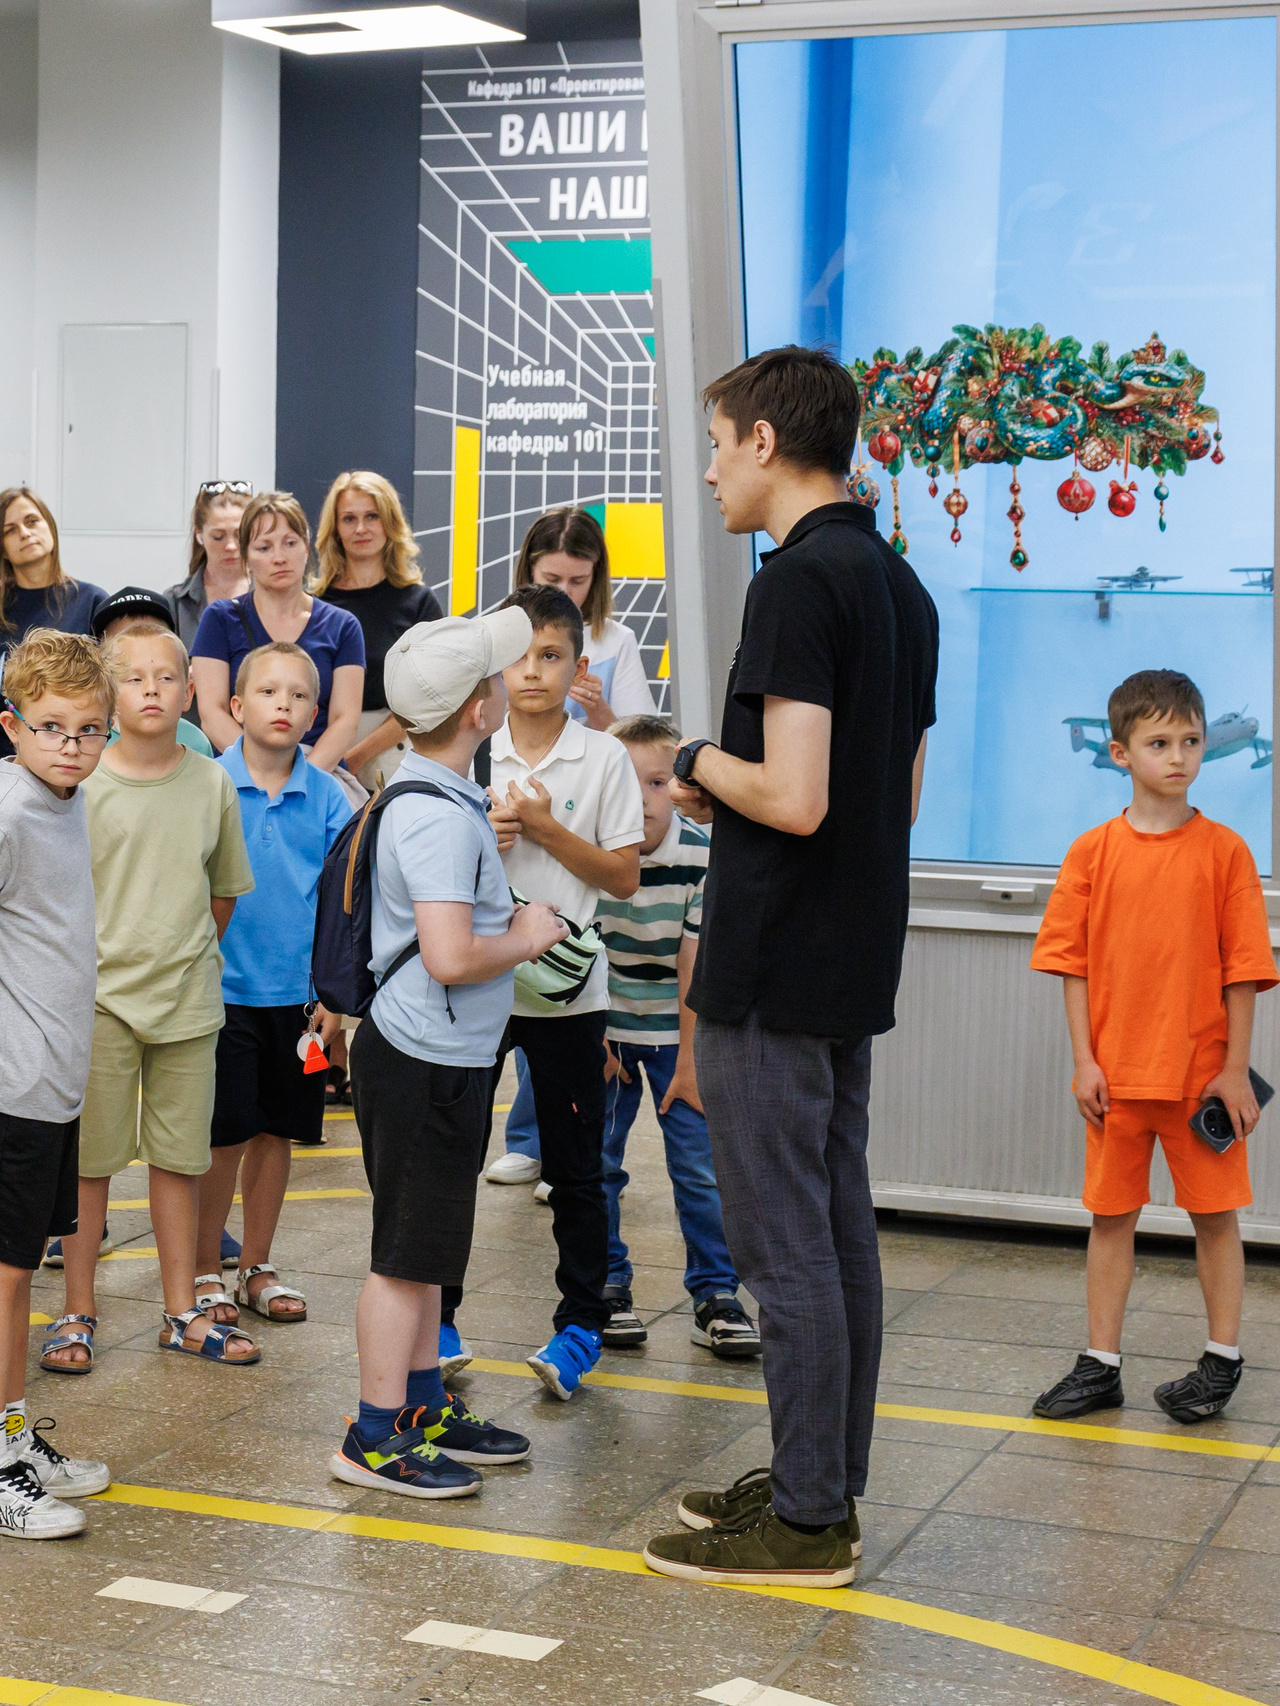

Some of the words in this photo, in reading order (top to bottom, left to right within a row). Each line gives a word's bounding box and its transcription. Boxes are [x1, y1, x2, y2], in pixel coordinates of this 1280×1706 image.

[467, 79, 523, 100] Кафедра
[525, 77, 546, 95] 101
[499, 110, 627, 156] ВАШИ
[549, 175, 651, 221] НАШ
[488, 364, 566, 387] Учебная
[486, 397, 588, 425] лаборатория
[486, 430, 569, 458] кафедры
[573, 429, 604, 453] 101
